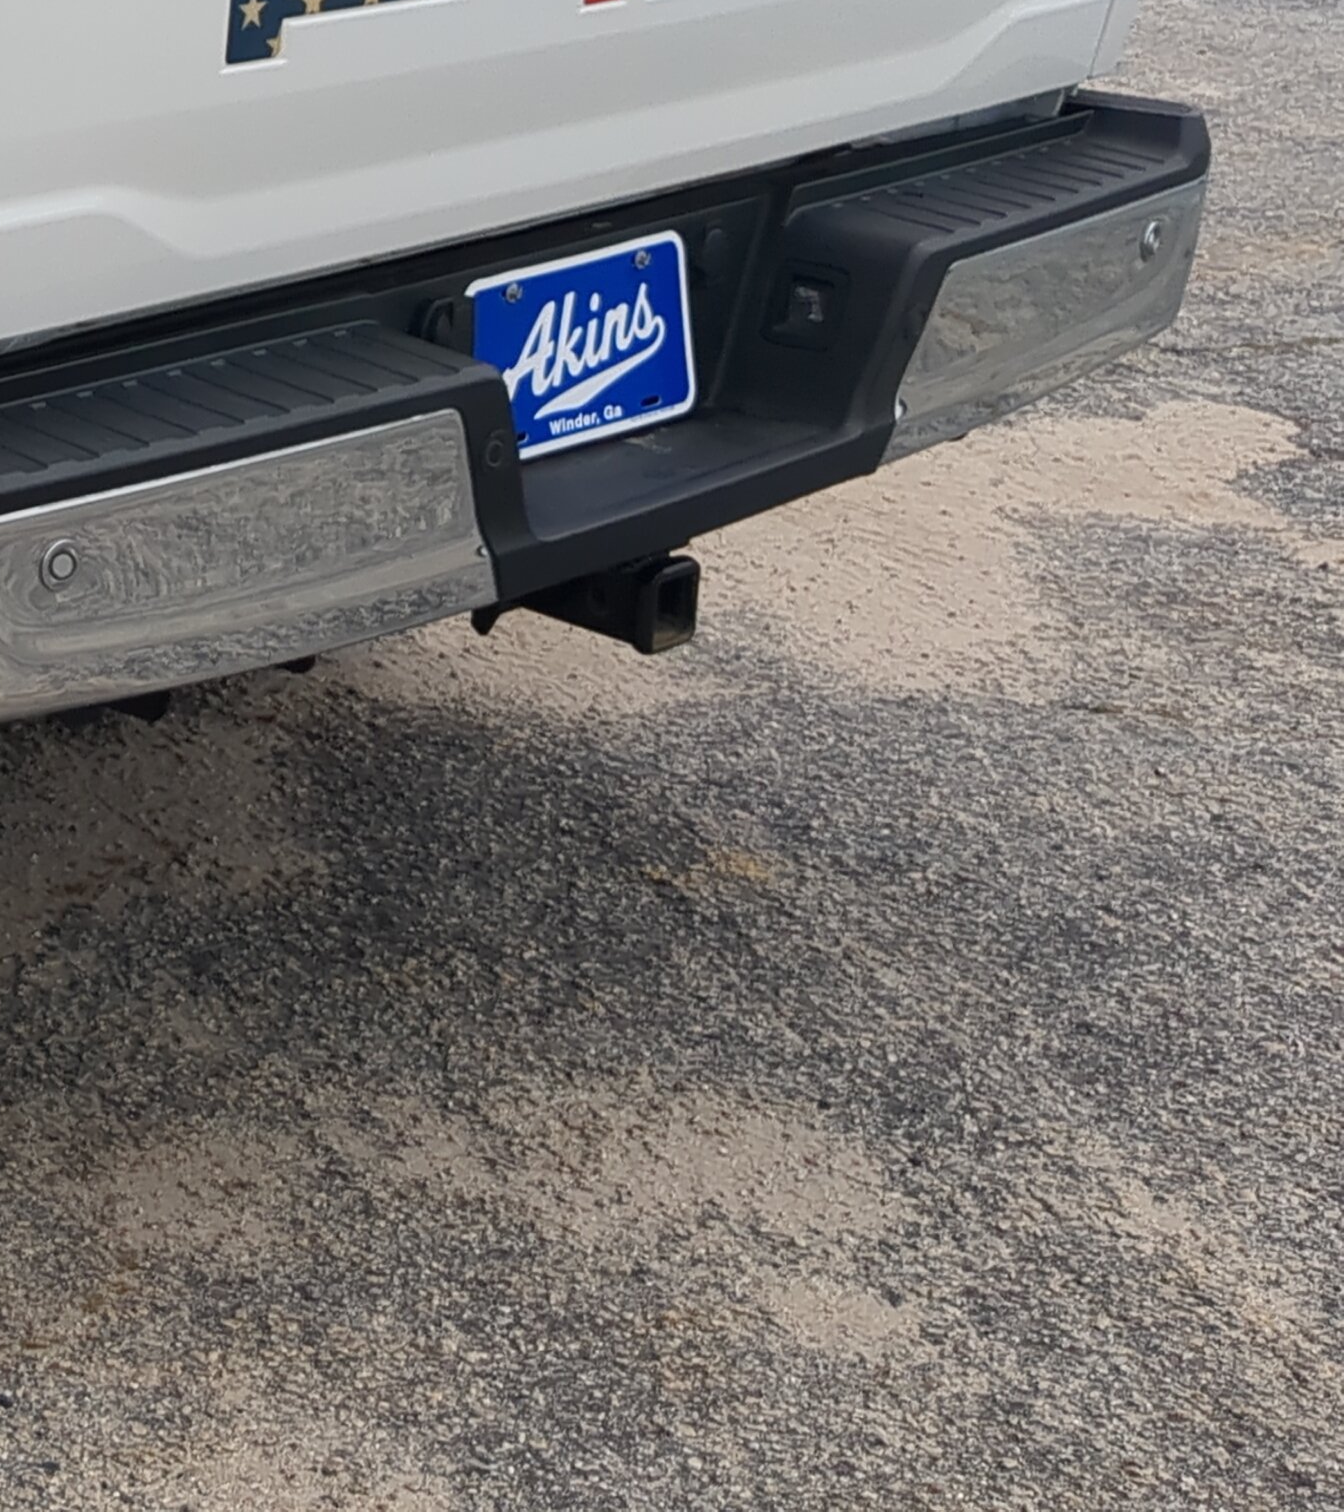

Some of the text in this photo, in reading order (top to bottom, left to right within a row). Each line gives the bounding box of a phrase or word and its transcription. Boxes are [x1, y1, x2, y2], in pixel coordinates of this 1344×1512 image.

[502, 282, 666, 420] Akins
[548, 412, 601, 435] Winder,
[603, 404, 623, 421] Ga
